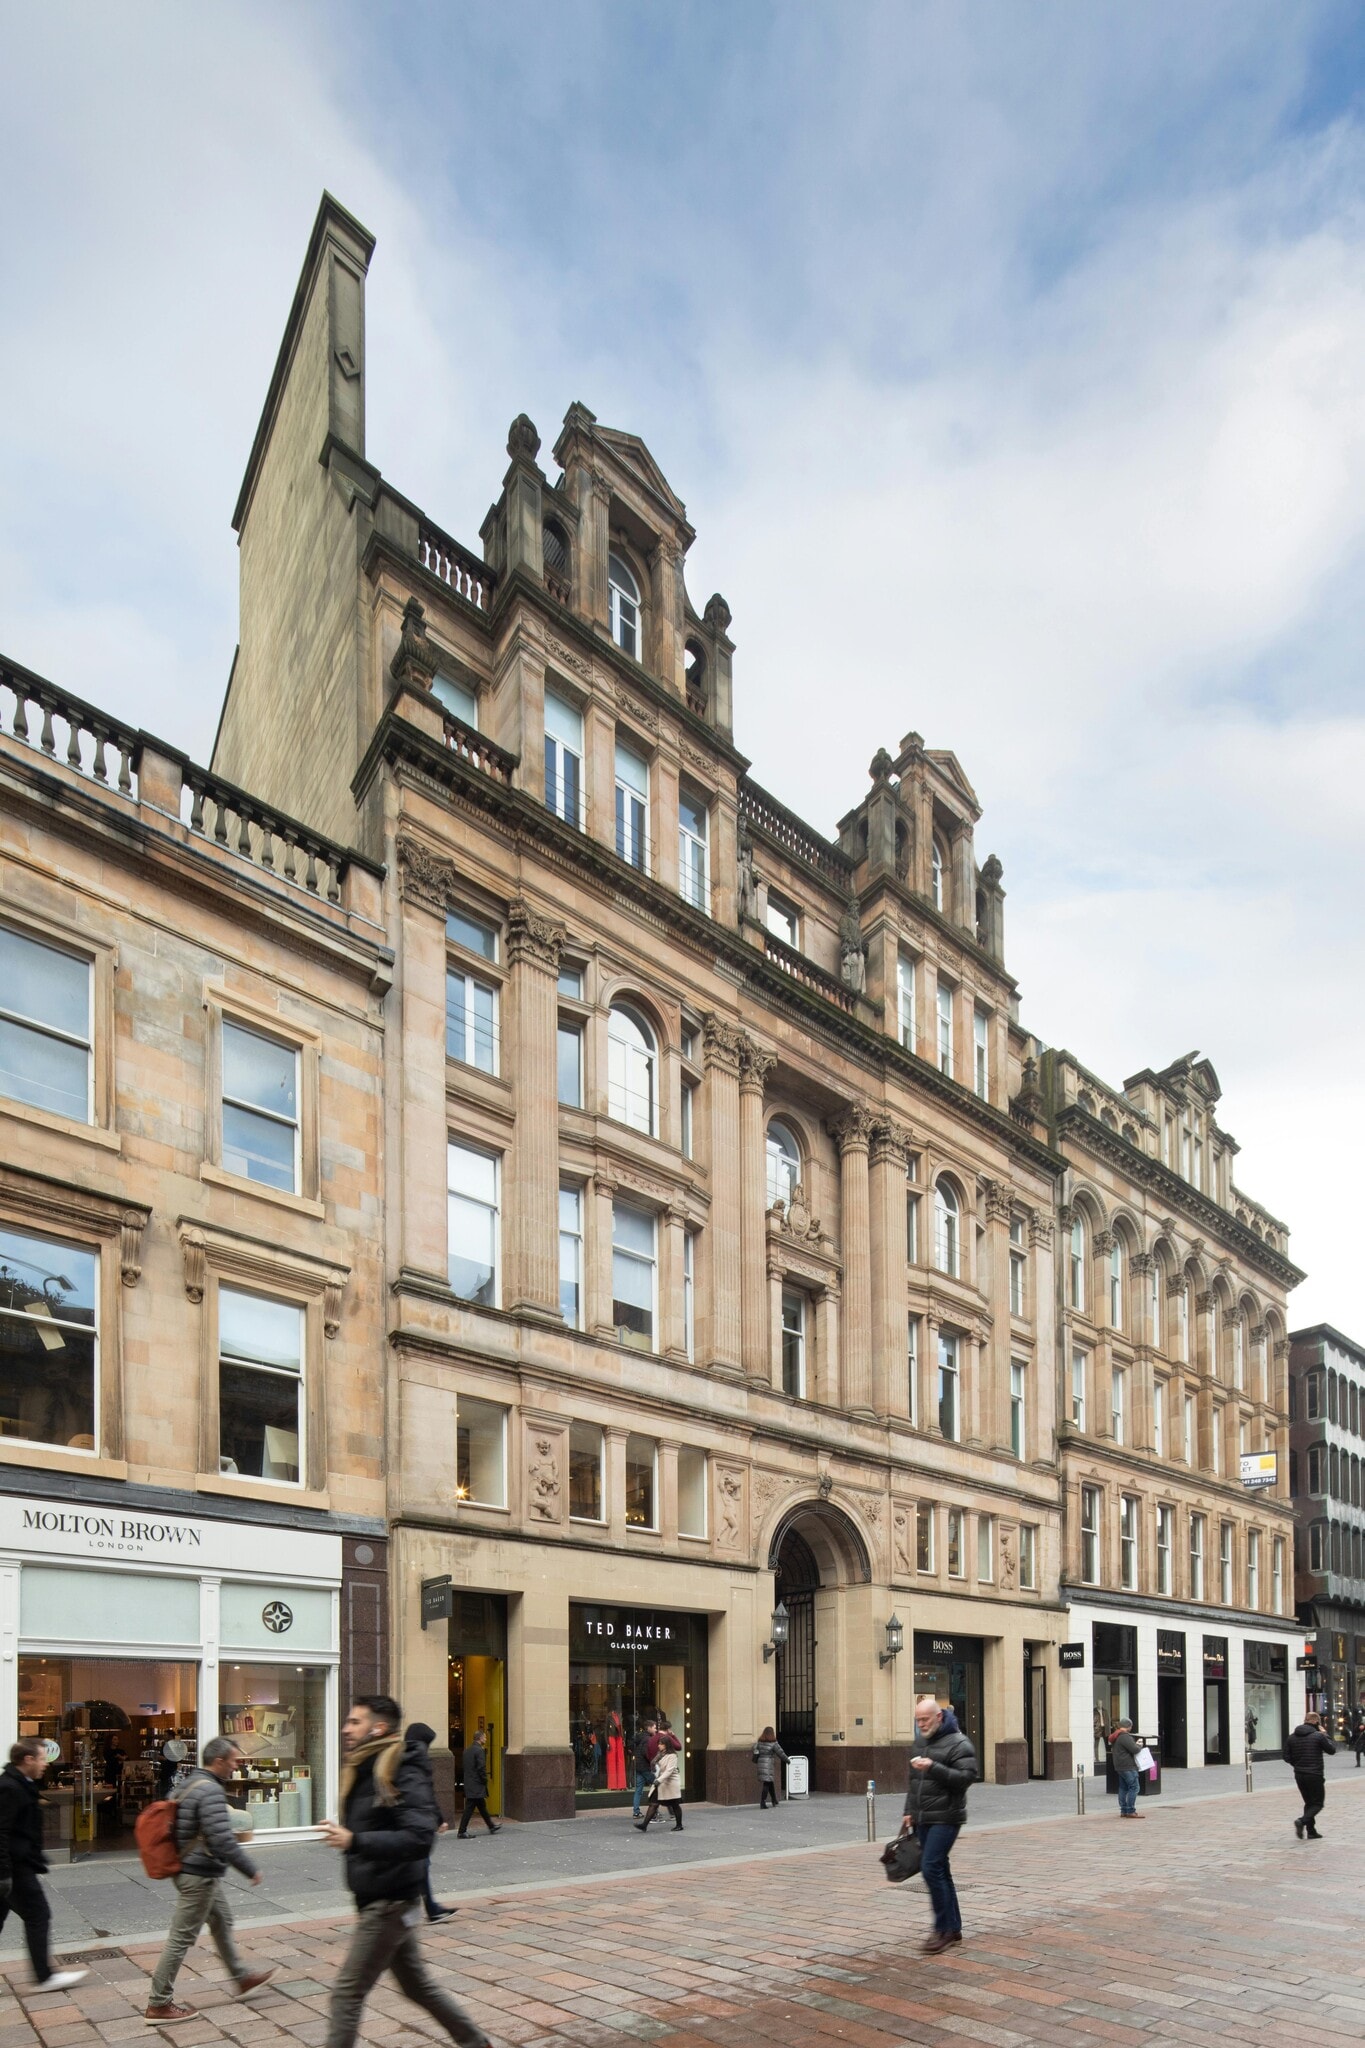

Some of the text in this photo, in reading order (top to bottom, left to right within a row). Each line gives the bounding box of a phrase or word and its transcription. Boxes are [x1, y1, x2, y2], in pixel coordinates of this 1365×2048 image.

[22, 1509, 202, 1546] MOLTON BROWN
[89, 1540, 143, 1551] LONDON
[586, 1621, 671, 1639] TED BAKER
[610, 1642, 649, 1650] GLASGOW
[932, 1640, 954, 1651] BOSS
[1063, 1650, 1082, 1658] BOSS
